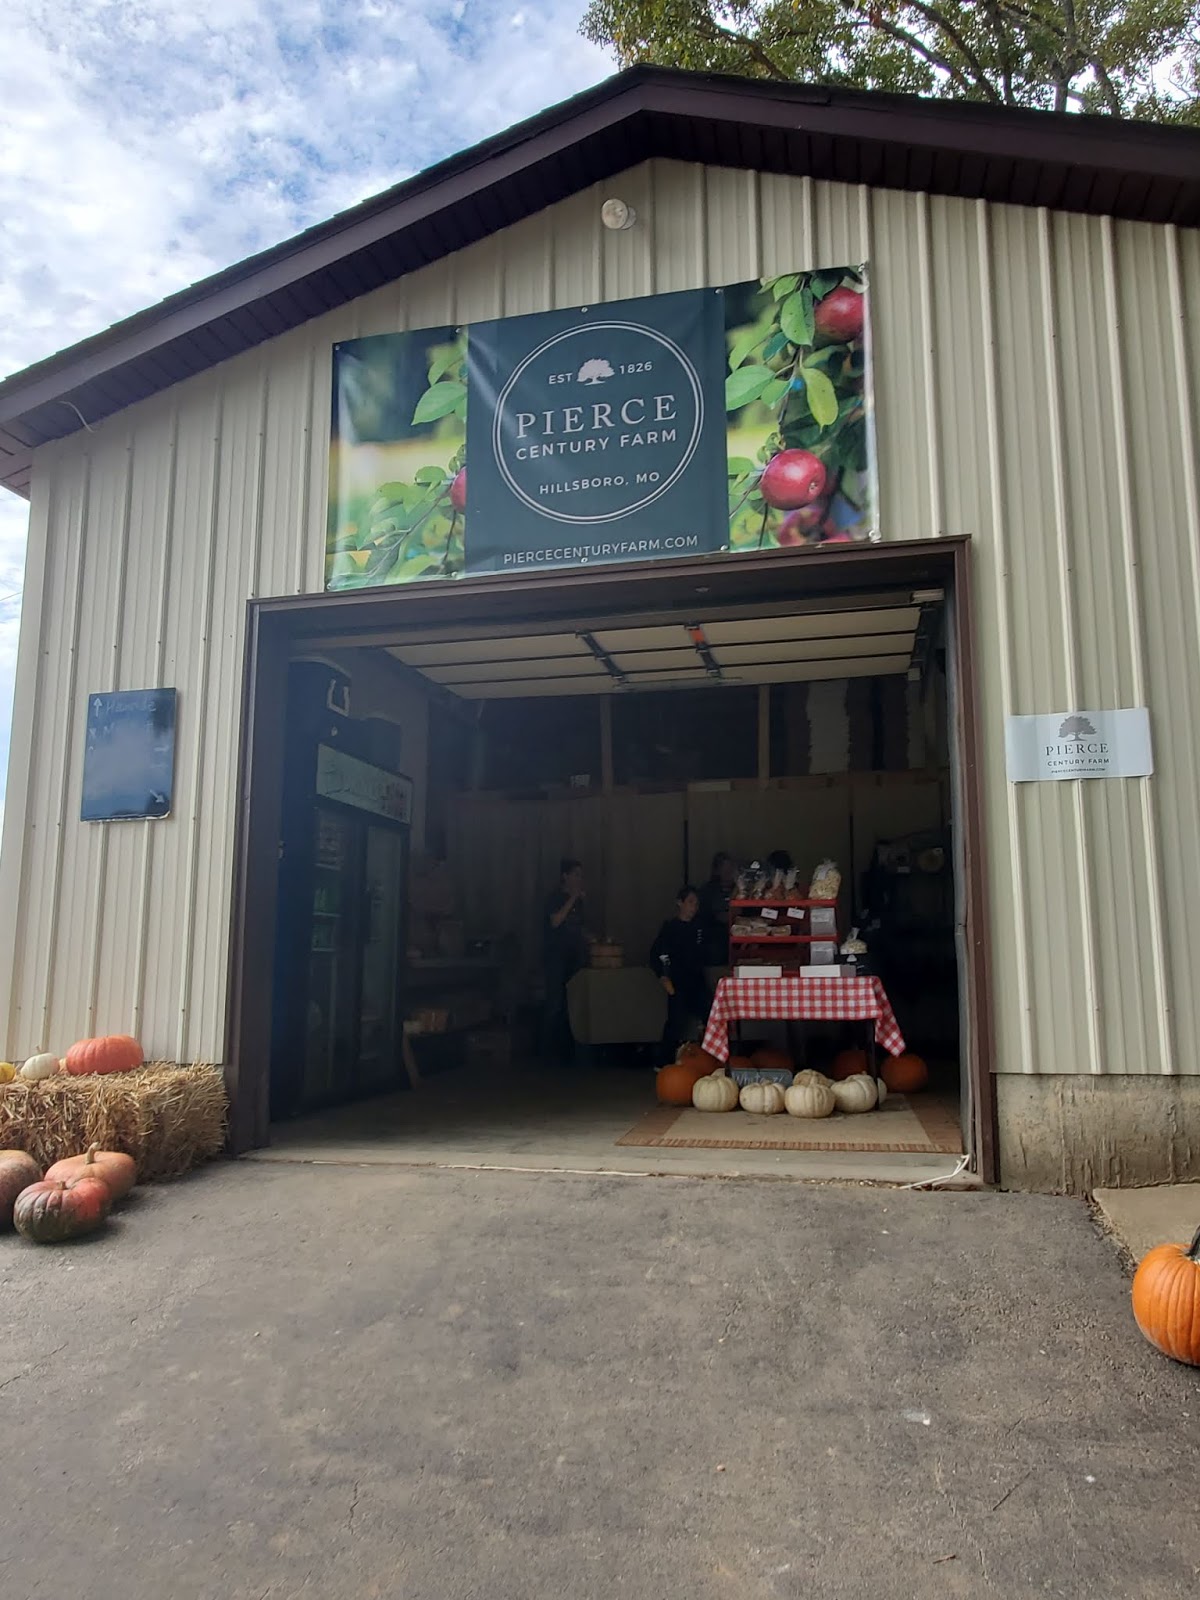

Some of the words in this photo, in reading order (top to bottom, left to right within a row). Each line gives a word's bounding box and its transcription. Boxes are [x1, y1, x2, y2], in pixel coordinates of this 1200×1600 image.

[548, 372, 573, 385] EST
[619, 361, 653, 374] 1826
[516, 394, 677, 439] PIERCE
[516, 437, 610, 461] CENTURY
[620, 428, 677, 448] FARM
[539, 475, 629, 495] HILLSBORO,
[636, 471, 660, 484] MO
[503, 535, 698, 564] PIERCECENTURYFARM.COM
[1045, 743, 1109, 756] PIERCE
